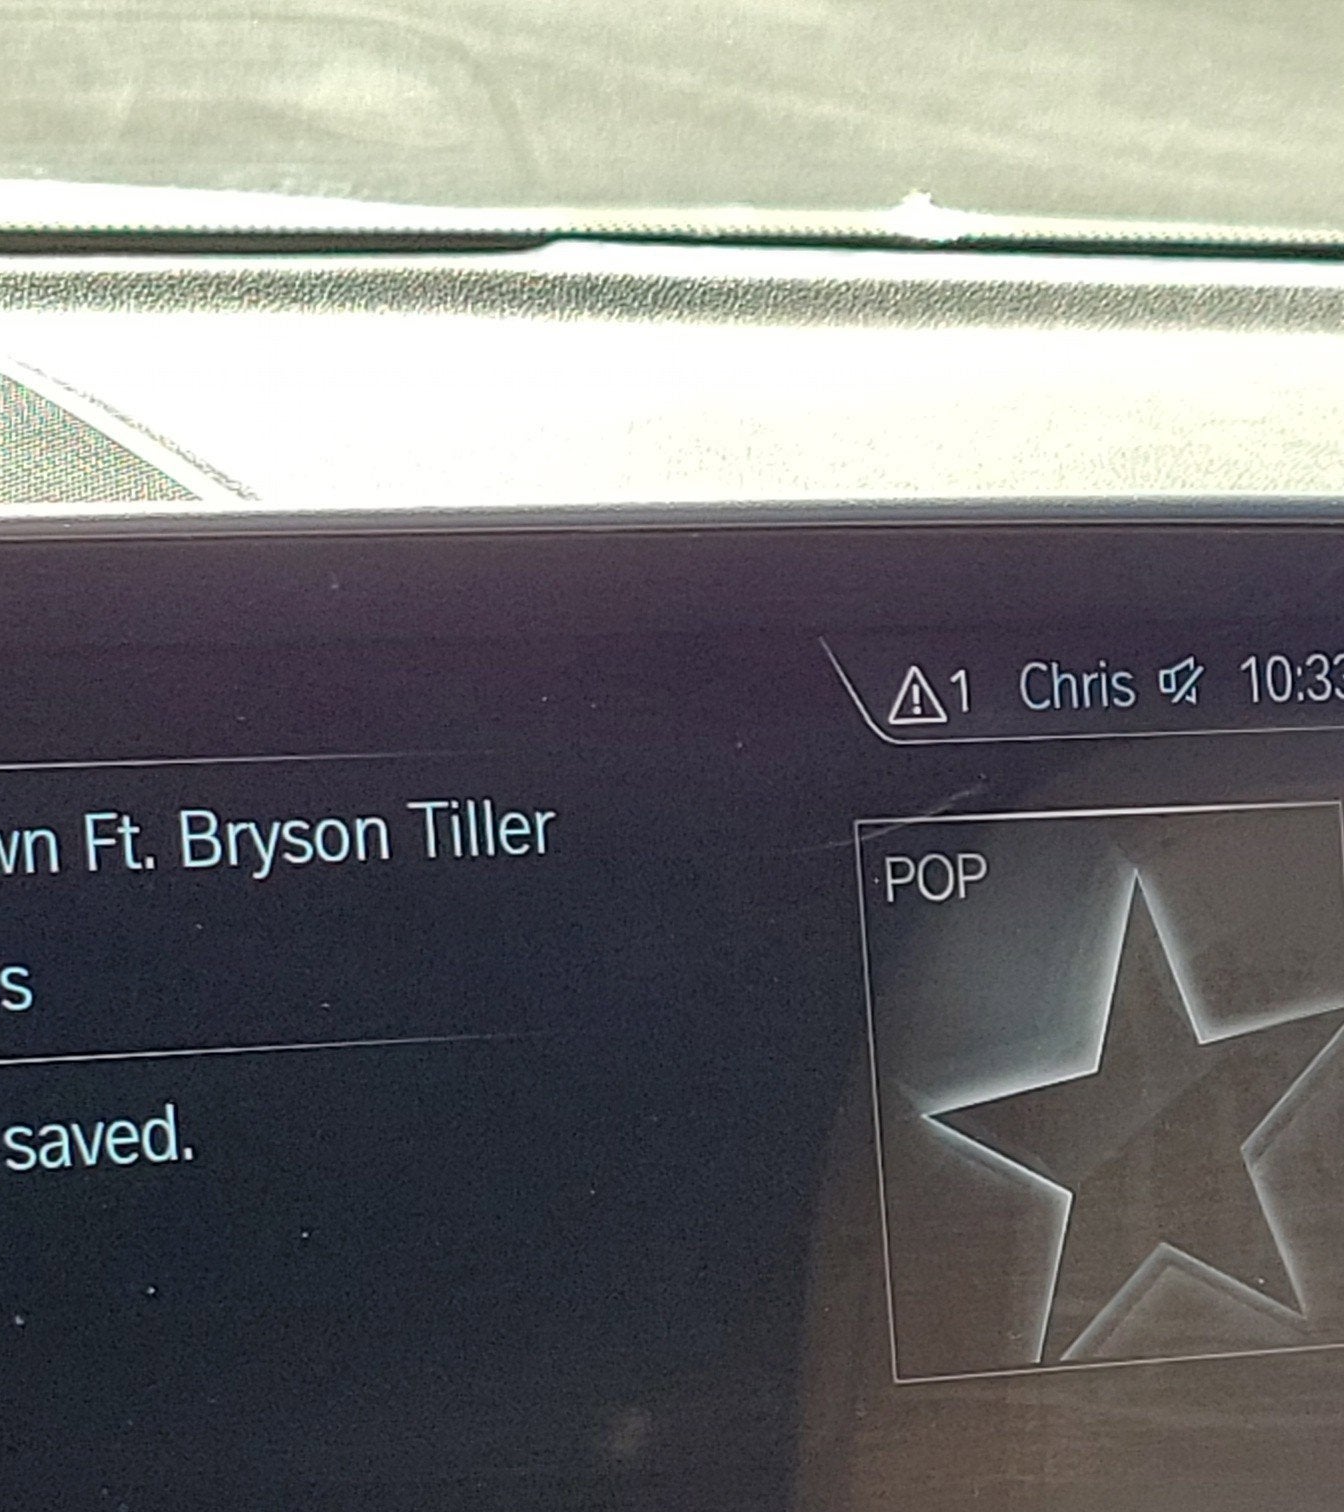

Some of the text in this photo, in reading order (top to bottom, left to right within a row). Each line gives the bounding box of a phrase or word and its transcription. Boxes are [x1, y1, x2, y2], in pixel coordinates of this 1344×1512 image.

[950, 669, 971, 713] 1
[1019, 660, 1137, 711] Chris
[83, 811, 157, 872] Ft.
[178, 808, 391, 880] Bryson
[406, 798, 557, 858] Tiller
[883, 853, 989, 903] POP
[3, 1102, 195, 1172] saved.
